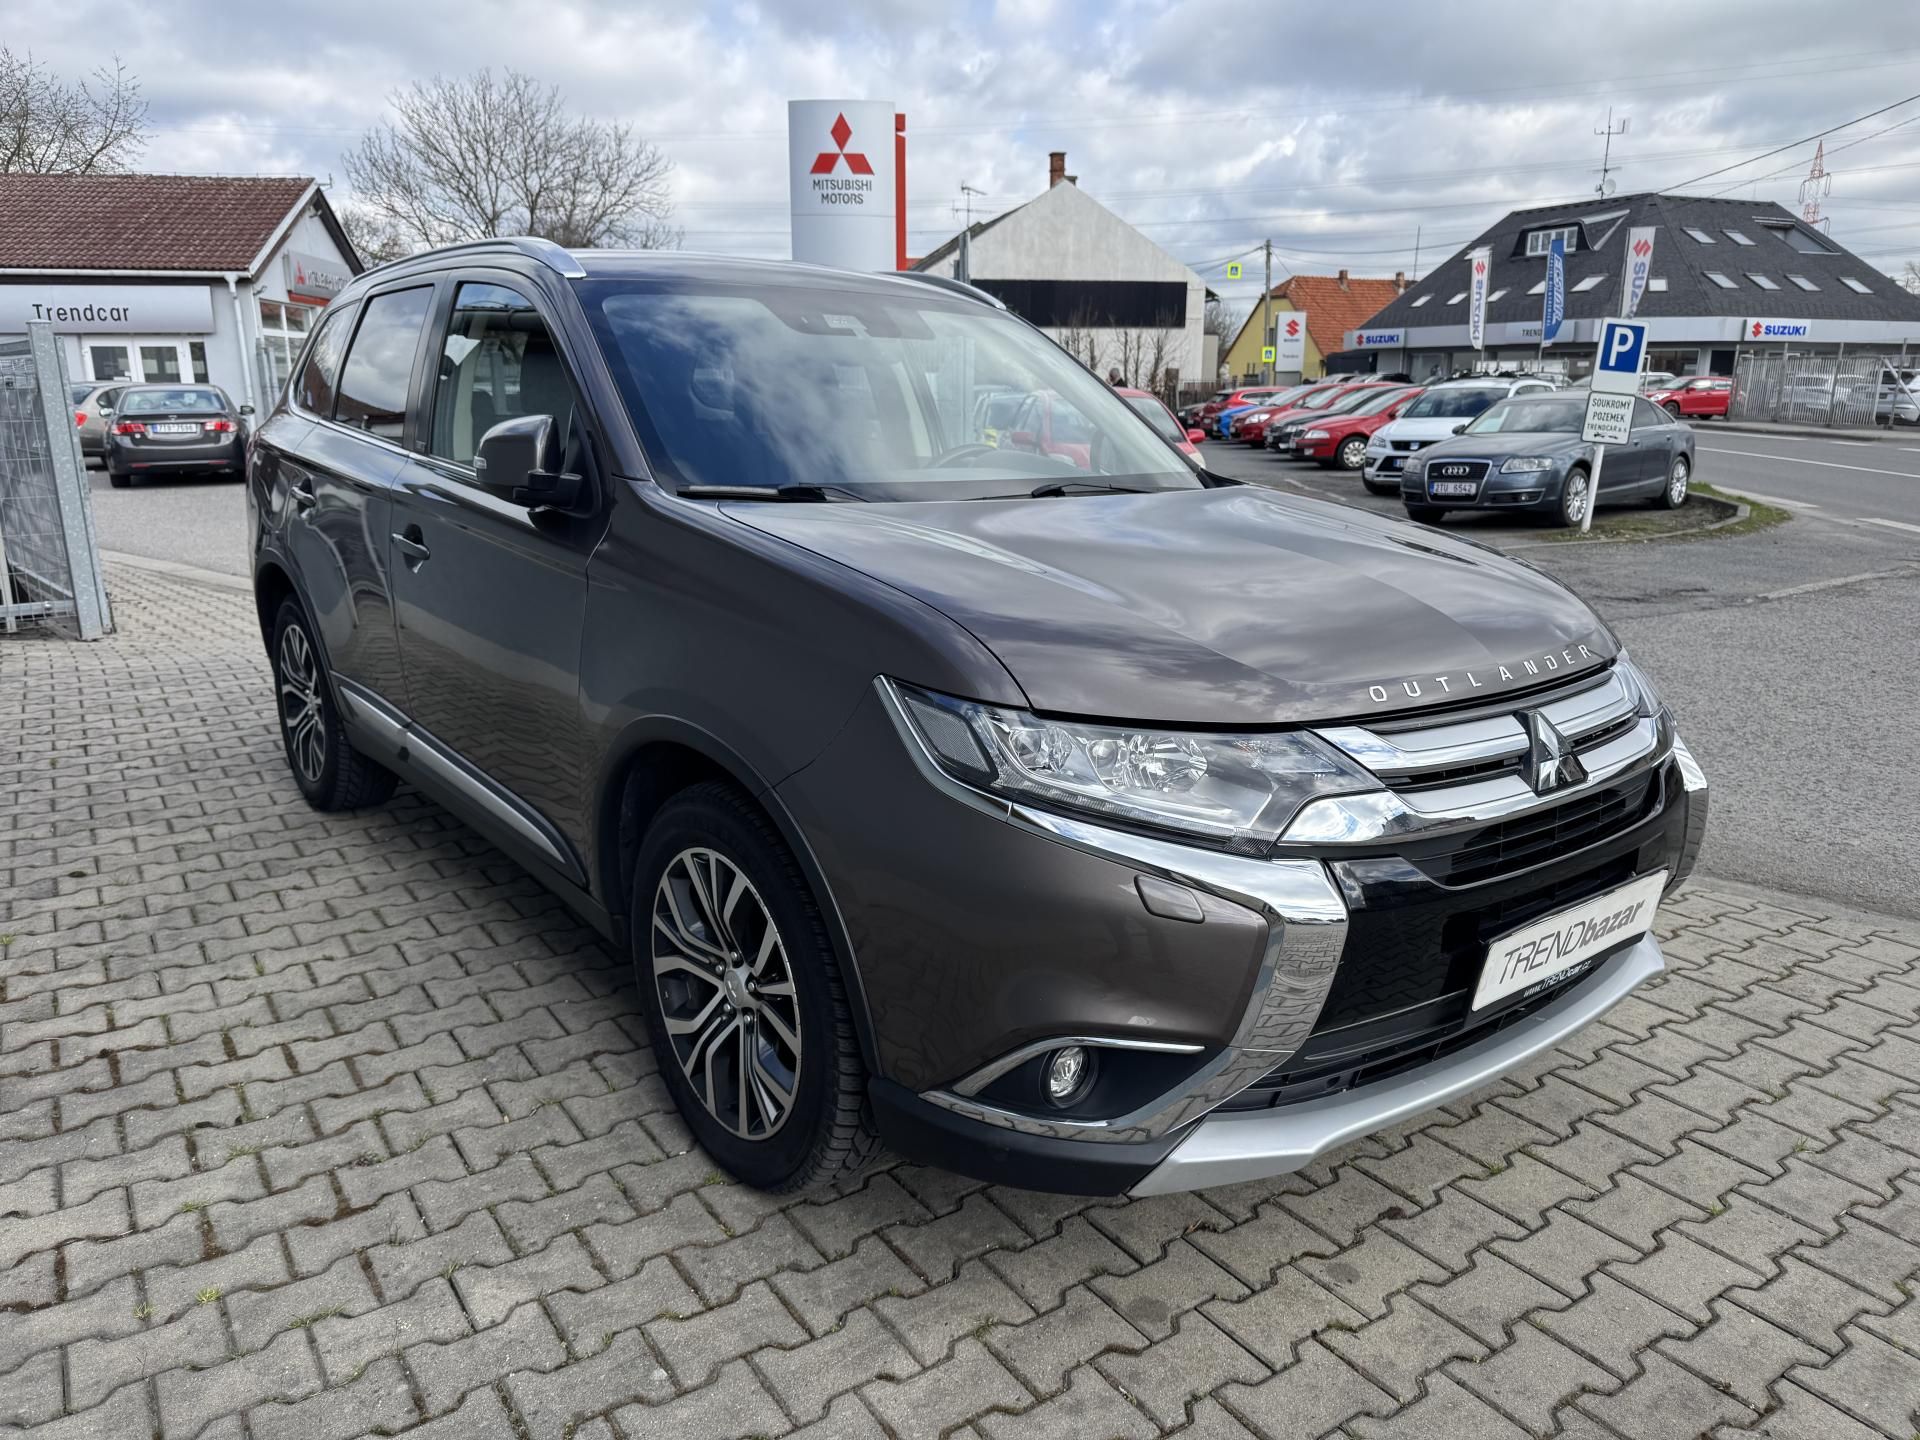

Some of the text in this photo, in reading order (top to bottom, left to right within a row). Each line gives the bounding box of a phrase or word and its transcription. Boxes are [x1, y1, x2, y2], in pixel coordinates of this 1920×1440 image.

[812, 179, 872, 191] MITSUBISHI
[820, 192, 864, 205] MOTORS
[32, 303, 129, 322] Trendcar
[1765, 325, 1807, 336] SUZUKI
[1365, 335, 1399, 345] SUZUKI
[1608, 326, 1635, 367] P
[1592, 398, 1631, 410] SOUKROMÝ
[1592, 411, 1625, 423] POZEMEK
[1369, 644, 1592, 702] OUTLANDER
[1499, 899, 1646, 985] TRENDbazar
